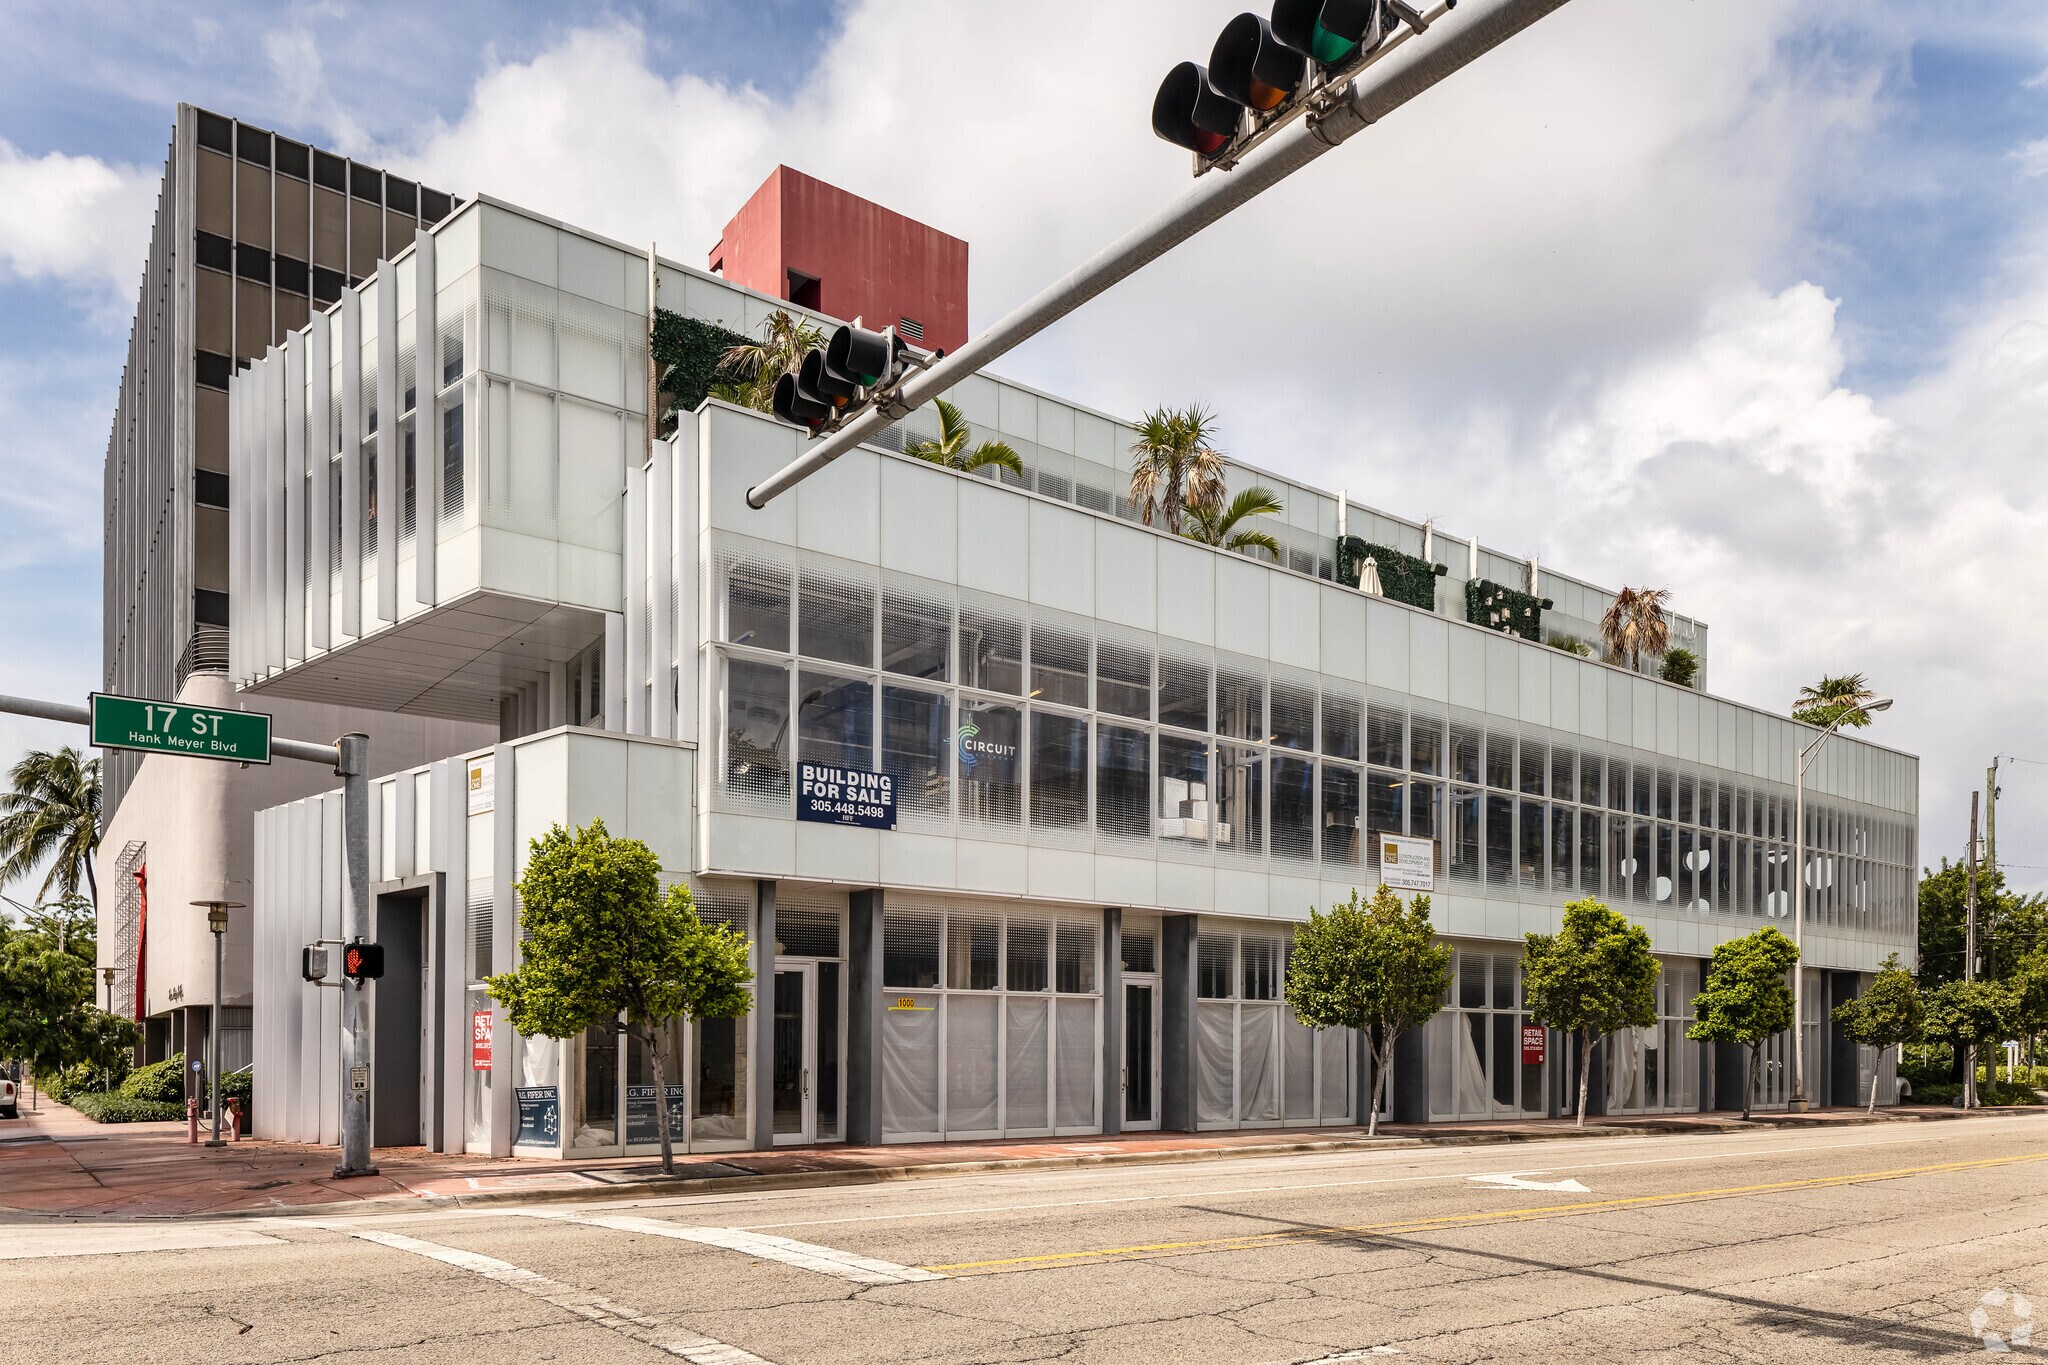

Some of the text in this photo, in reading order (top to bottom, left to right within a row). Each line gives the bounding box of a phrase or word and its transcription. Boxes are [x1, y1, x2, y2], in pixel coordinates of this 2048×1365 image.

[145, 705, 223, 736] 17 ST
[129, 731, 237, 753] Hank Meyer Blvd
[964, 739, 1016, 756] CIRCUIT
[802, 765, 892, 790] BUILDING
[802, 780, 892, 806] FOR SALE
[810, 799, 884, 818] 305.448.5498
[898, 998, 915, 1008] 1000
[475, 1015, 492, 1027] RET
[475, 1028, 492, 1041] SPA
[1524, 1029, 1543, 1037] RETAIL
[1524, 1037, 1543, 1045] SPACE
[544, 1089, 556, 1098] INC.
[627, 1088, 639, 1097] .G.
[641, 1087, 669, 1096] FIFR
